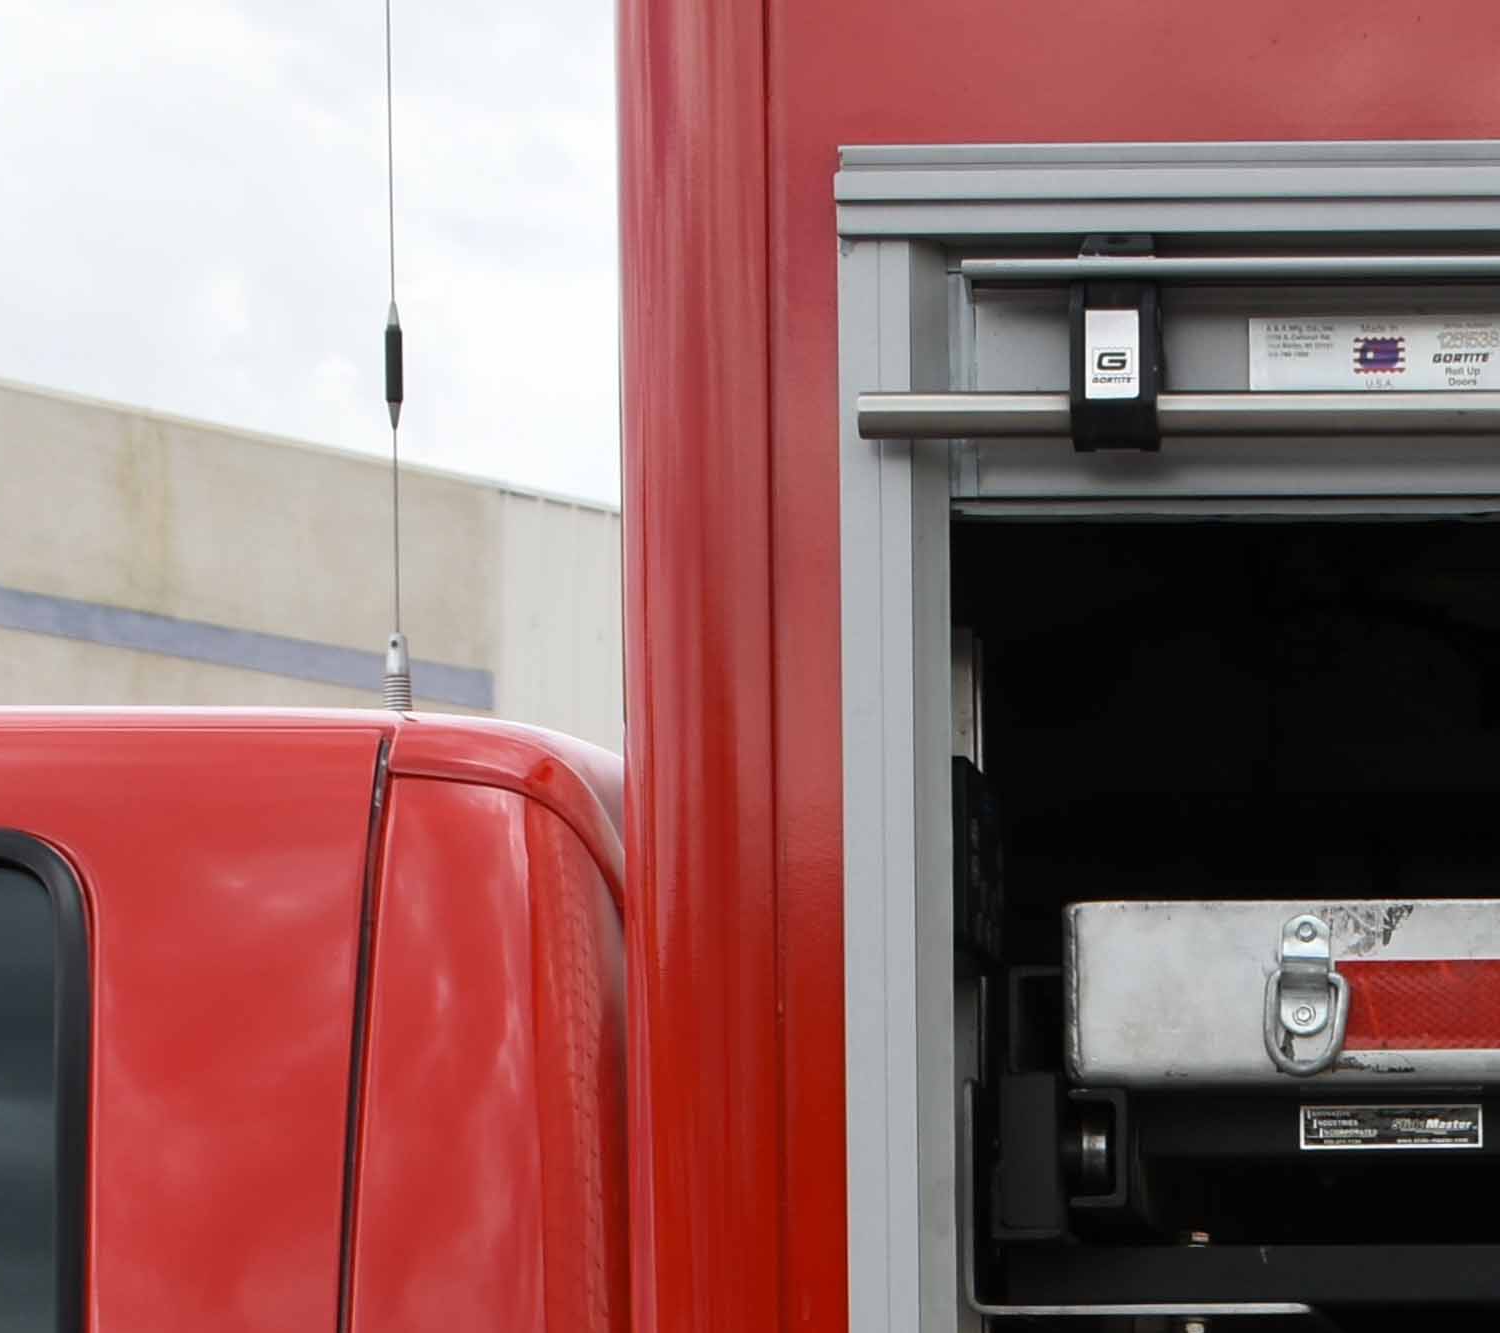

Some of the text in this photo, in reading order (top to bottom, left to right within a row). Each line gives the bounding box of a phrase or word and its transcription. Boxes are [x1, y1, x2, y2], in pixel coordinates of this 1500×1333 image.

[1097, 352, 1126, 370] G
[1432, 353, 1490, 363] GORTITE
[1467, 367, 1481, 378] Up
